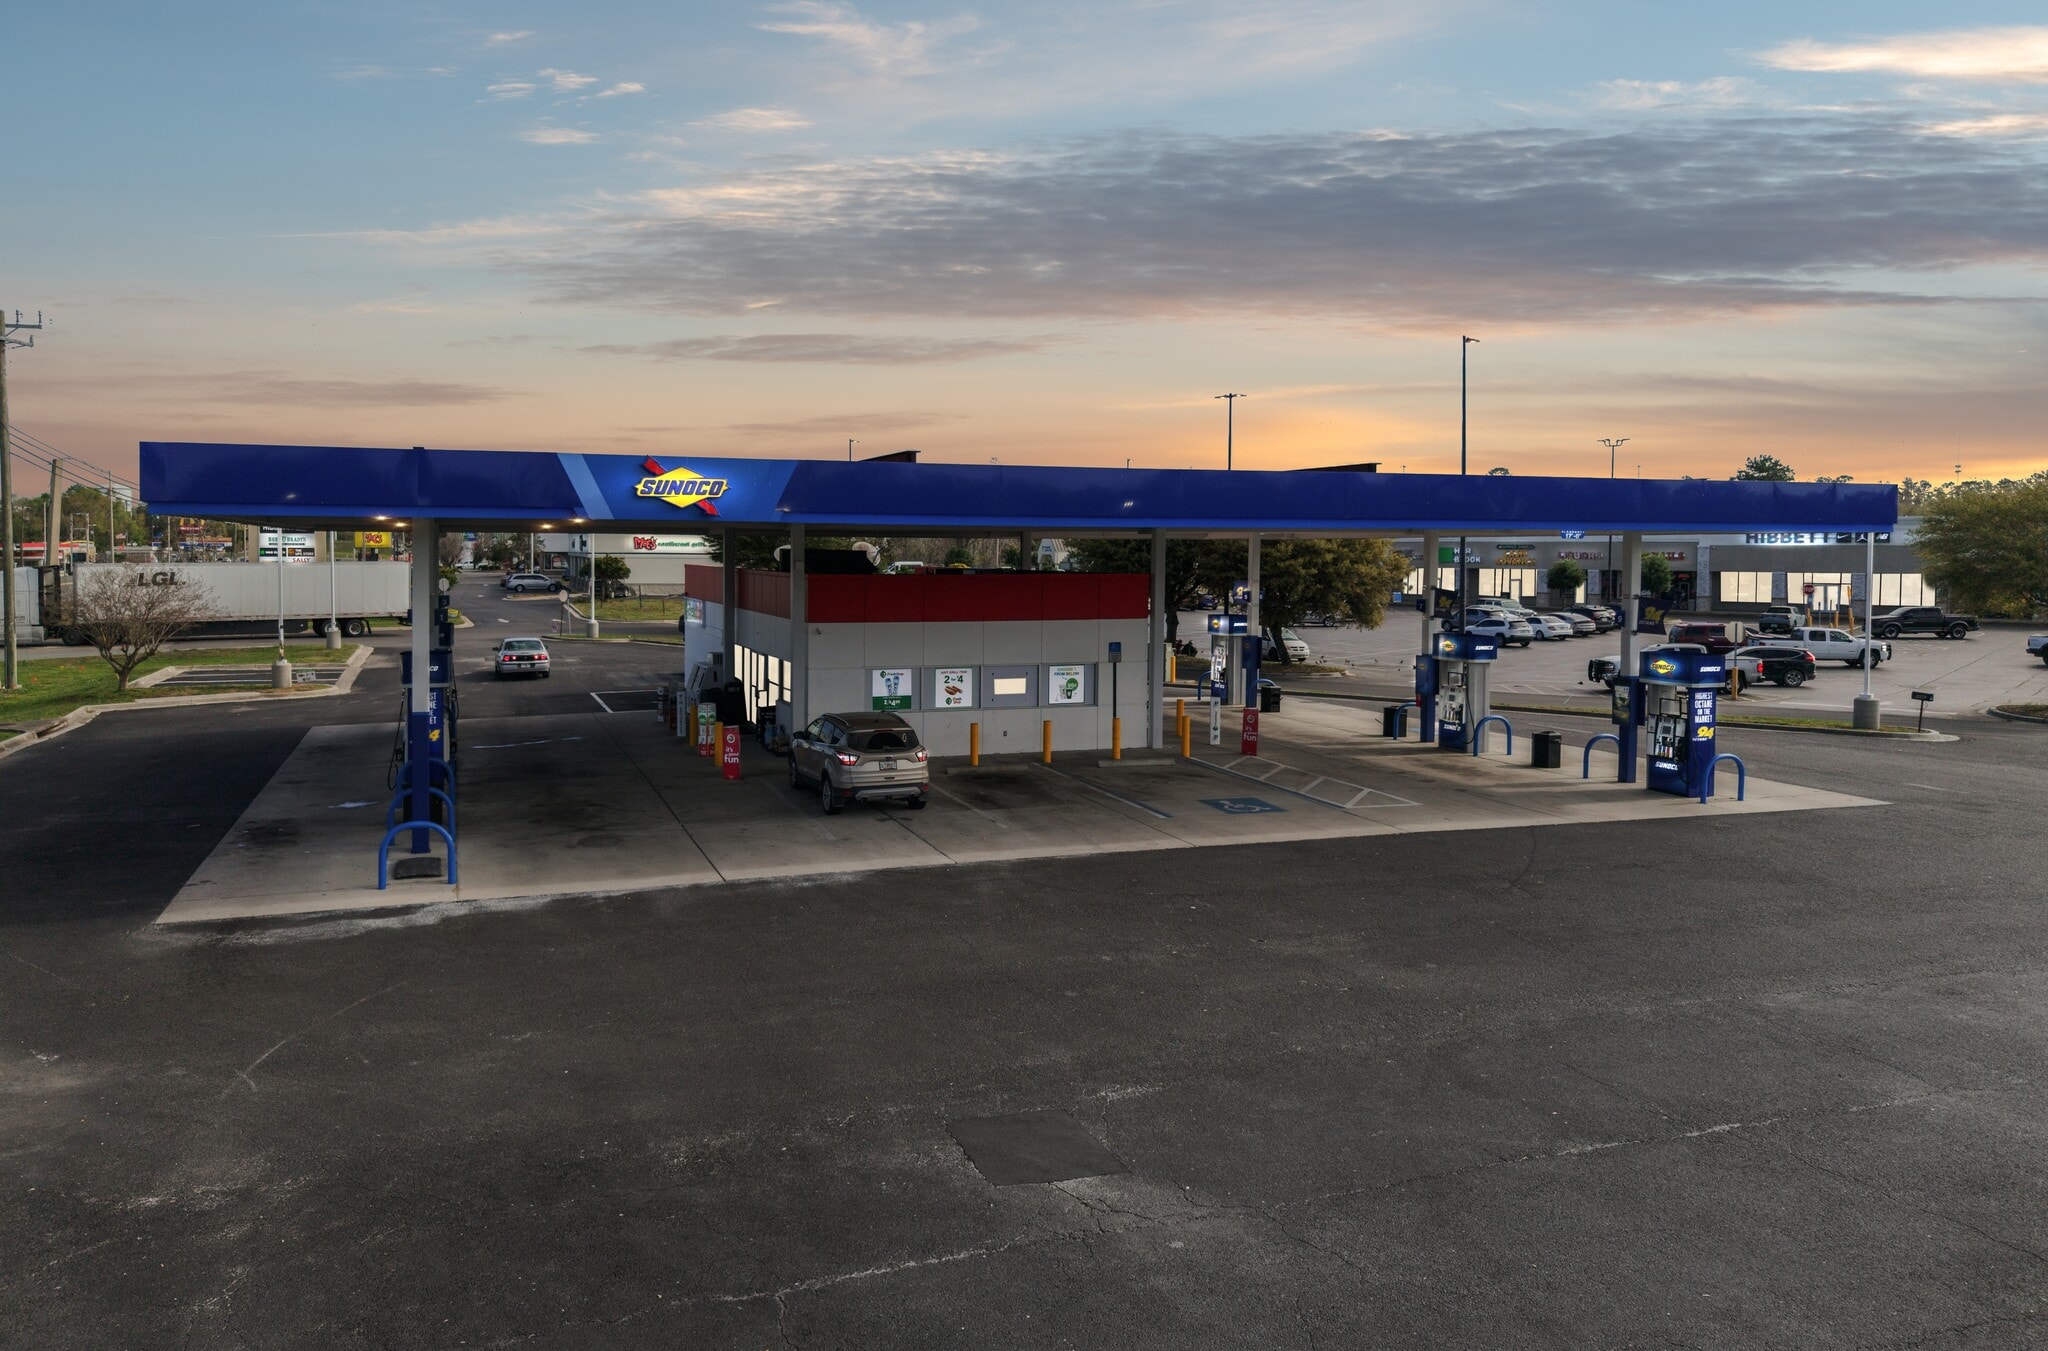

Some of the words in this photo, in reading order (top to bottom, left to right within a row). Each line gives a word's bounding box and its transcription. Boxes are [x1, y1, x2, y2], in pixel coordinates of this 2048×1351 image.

[640, 479, 724, 495] SUNOCO
[1454, 555, 1481, 563] BOCK
[1651, 663, 1675, 671] SUNOCO
[1694, 691, 1713, 700] HIGHEST
[1694, 700, 1713, 709] OCTANE
[1694, 715, 1713, 723] MARKET
[429, 729, 440, 741] 4
[1697, 726, 1714, 739] 94
[724, 754, 739, 763] fun
